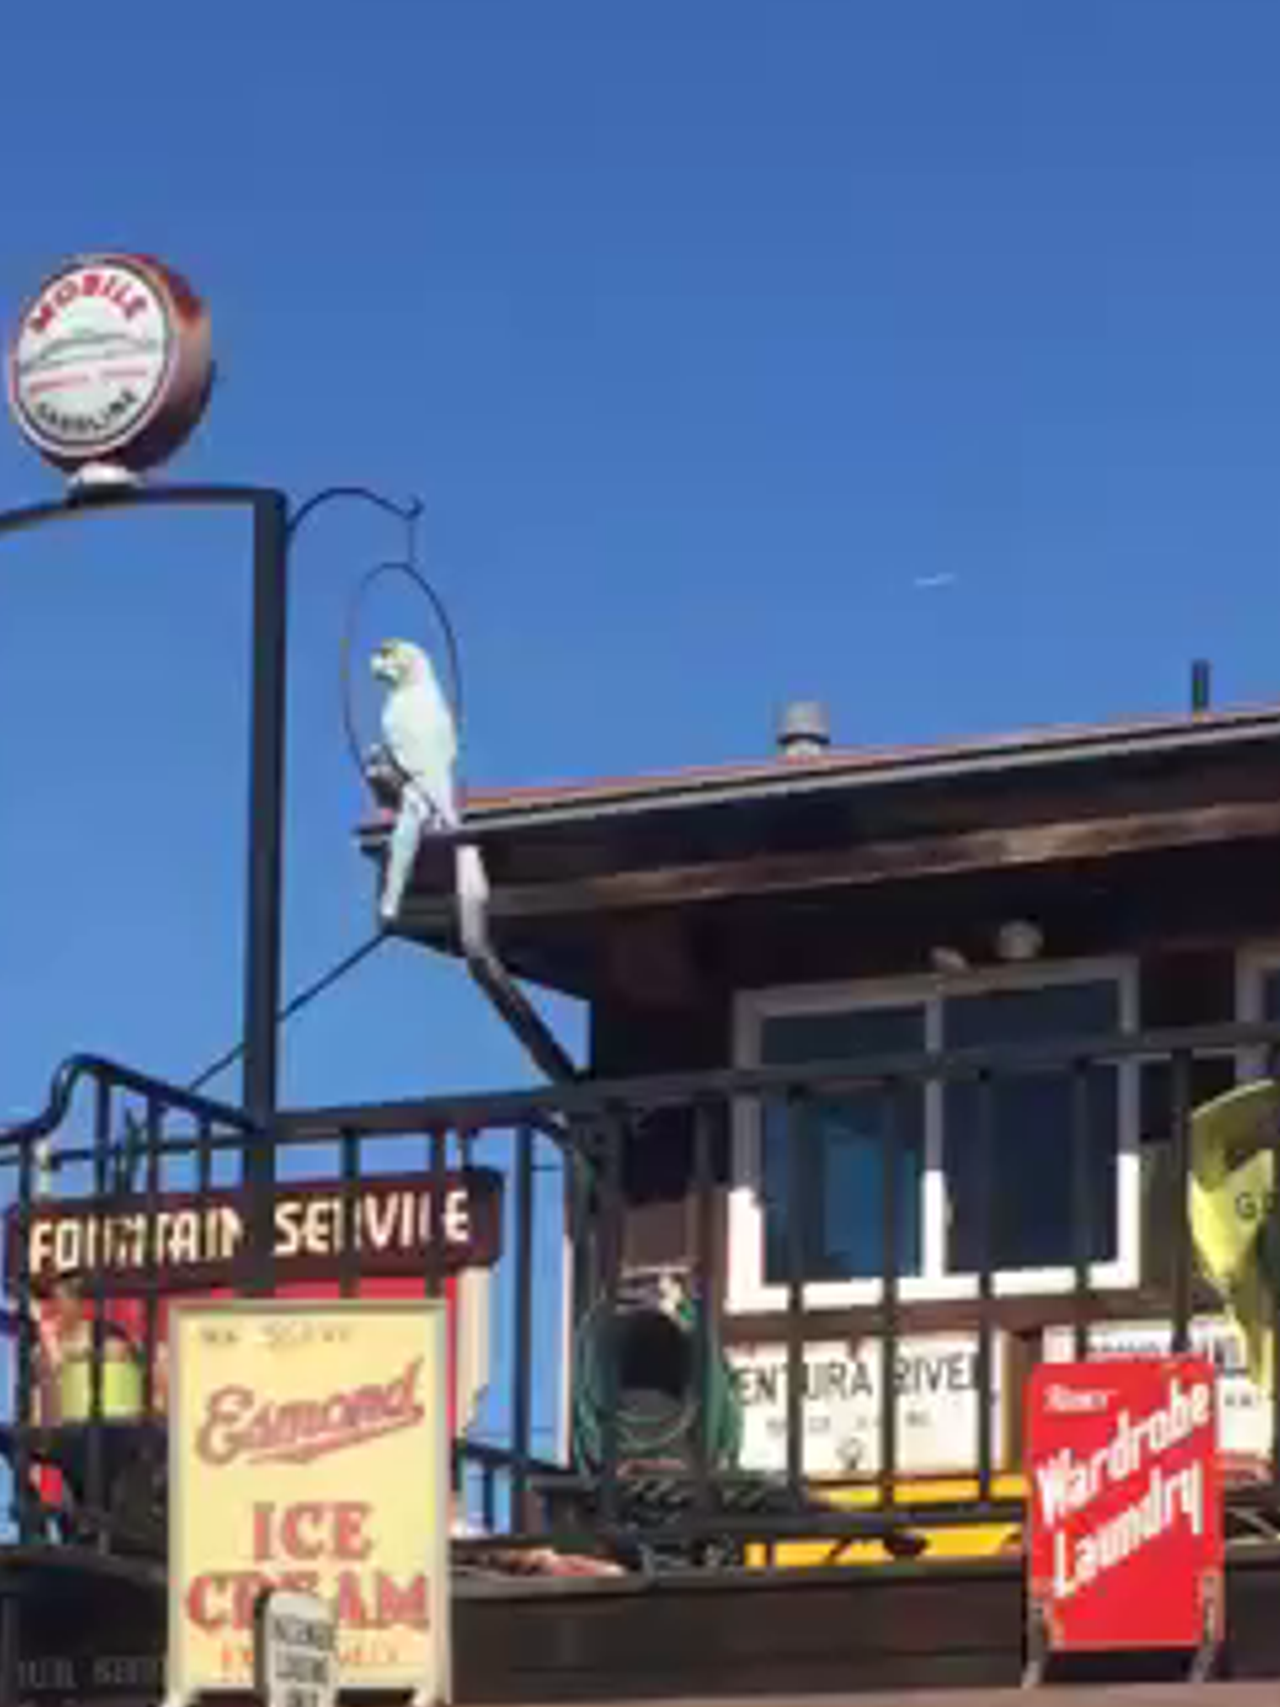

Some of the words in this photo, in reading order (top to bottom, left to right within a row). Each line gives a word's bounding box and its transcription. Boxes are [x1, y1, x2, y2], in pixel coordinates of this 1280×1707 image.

[1036, 1376, 1209, 1527] Wardrobe
[253, 1501, 374, 1561] ICE
[1054, 1459, 1203, 1599] Laundry
